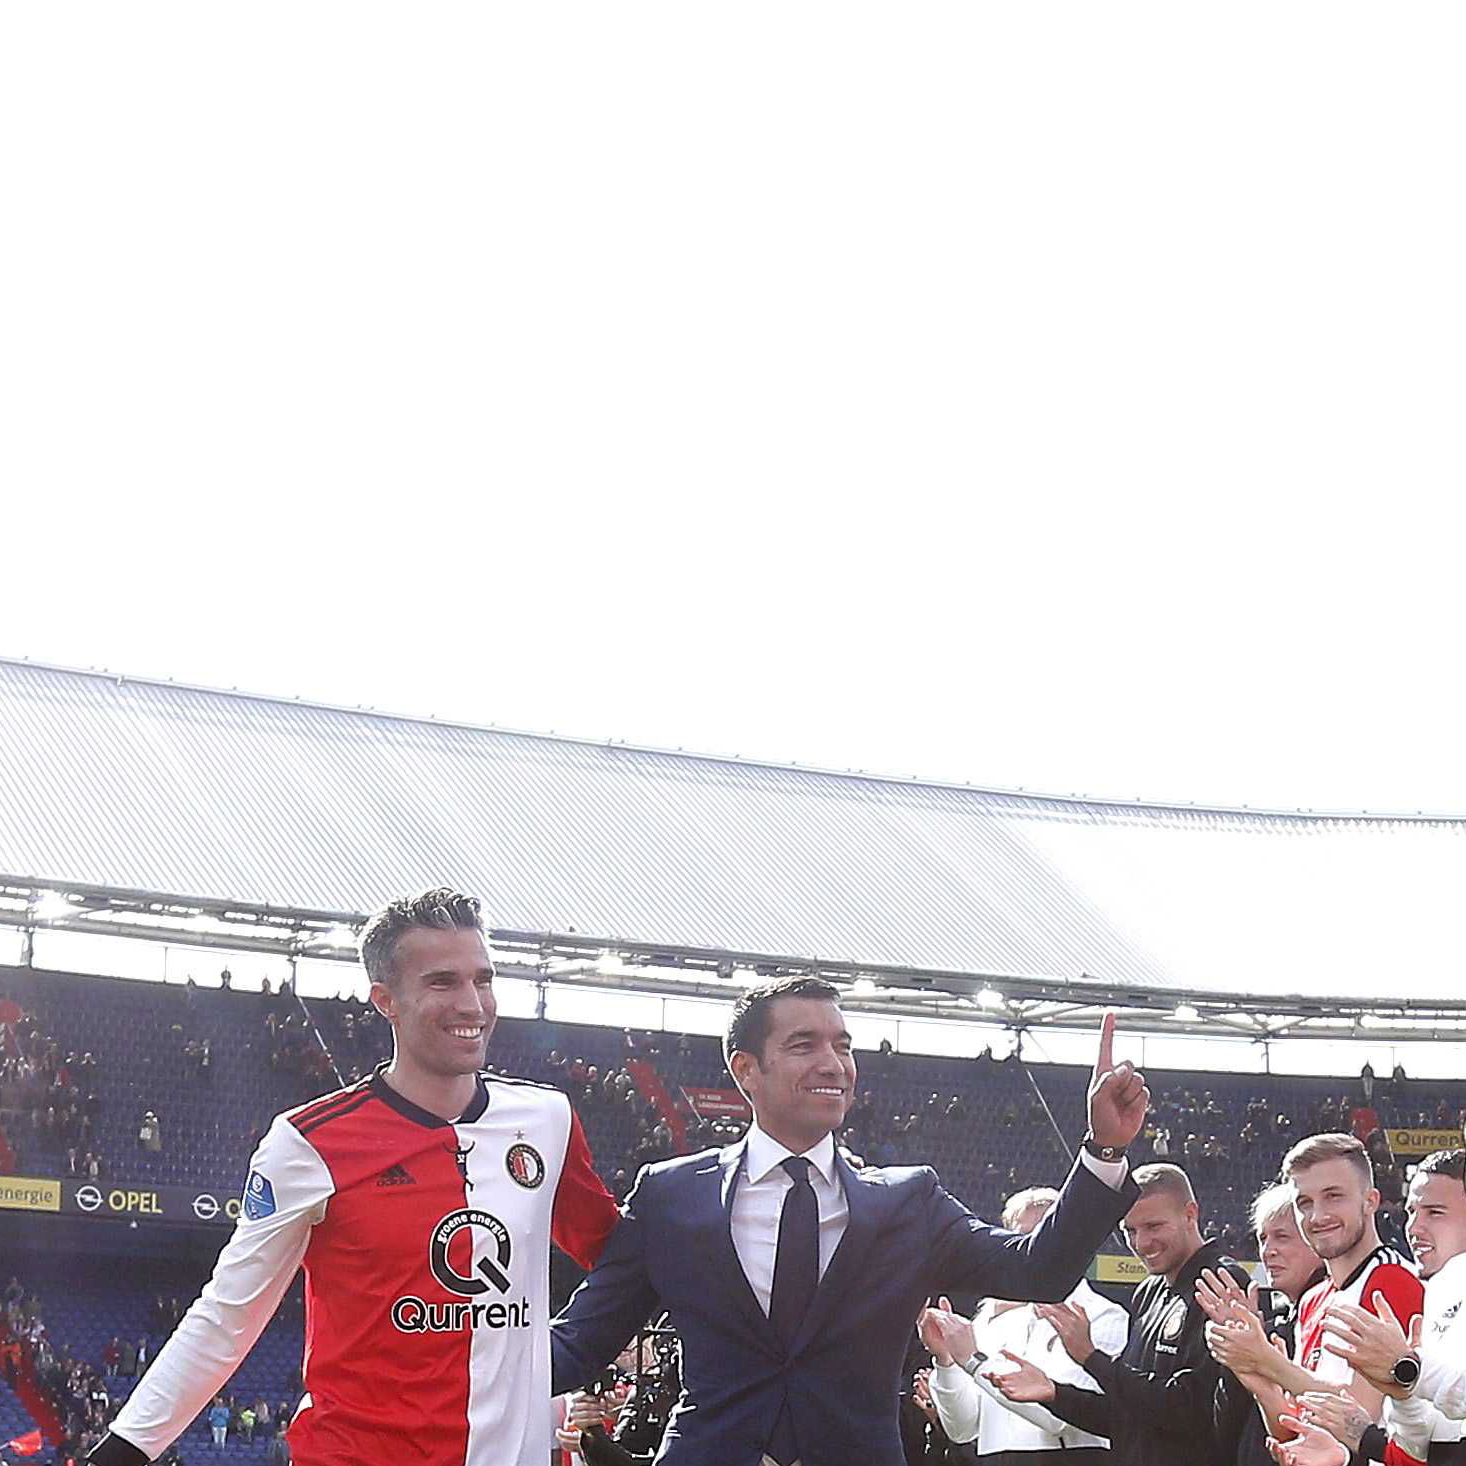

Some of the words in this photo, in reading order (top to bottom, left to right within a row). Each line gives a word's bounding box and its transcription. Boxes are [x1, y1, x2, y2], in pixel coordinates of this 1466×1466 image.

[1396, 1131, 1461, 1146] Qurren
[108, 1190, 164, 1214] OPEL
[391, 1295, 531, 1333] Qurrent
